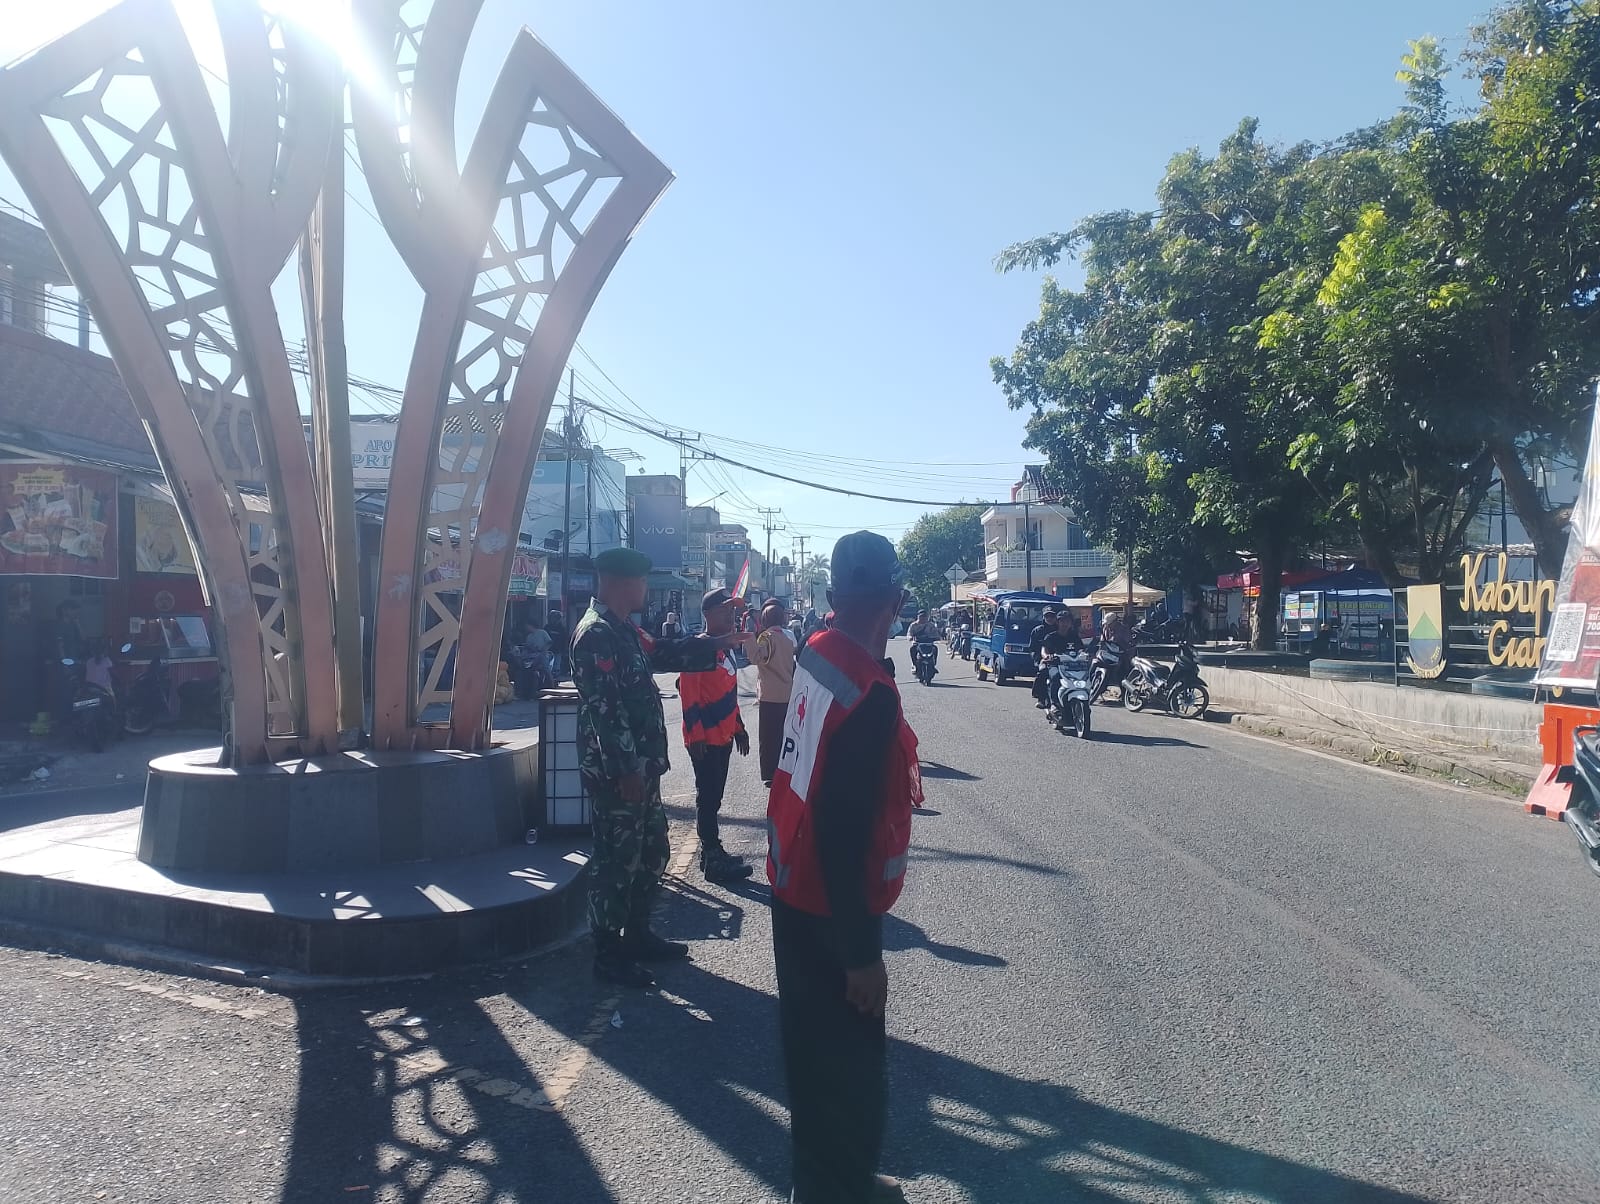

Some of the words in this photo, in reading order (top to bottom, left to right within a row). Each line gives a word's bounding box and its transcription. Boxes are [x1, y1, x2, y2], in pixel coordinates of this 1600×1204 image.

[352, 454, 392, 468] PRI
[641, 524, 675, 535] vivo
[782, 737, 796, 760] P
